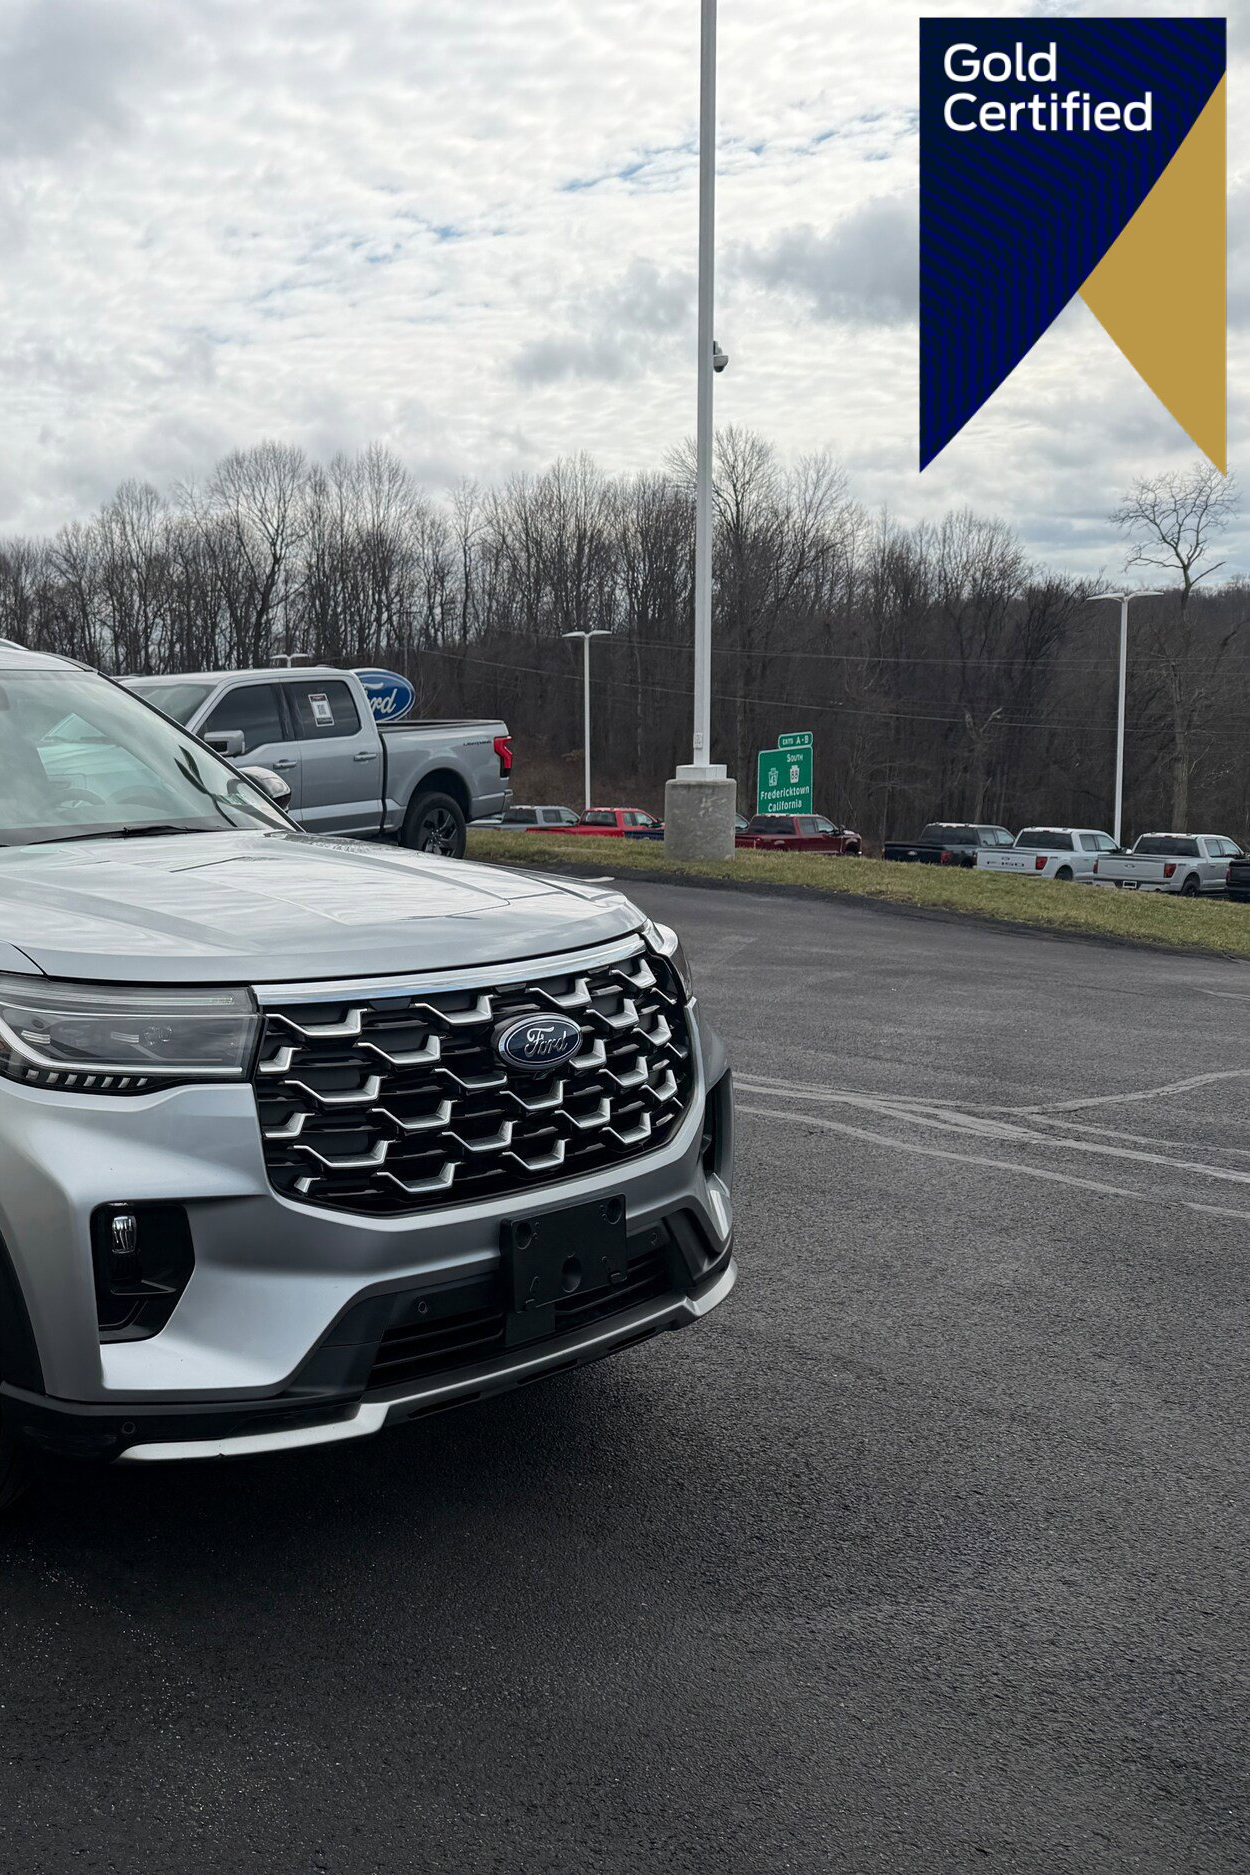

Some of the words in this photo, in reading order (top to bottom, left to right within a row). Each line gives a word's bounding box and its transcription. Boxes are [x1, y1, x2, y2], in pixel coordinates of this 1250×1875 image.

[760, 786, 810, 800] Fredericktown
[768, 799, 802, 812] California
[523, 1026, 568, 1058] Ford
